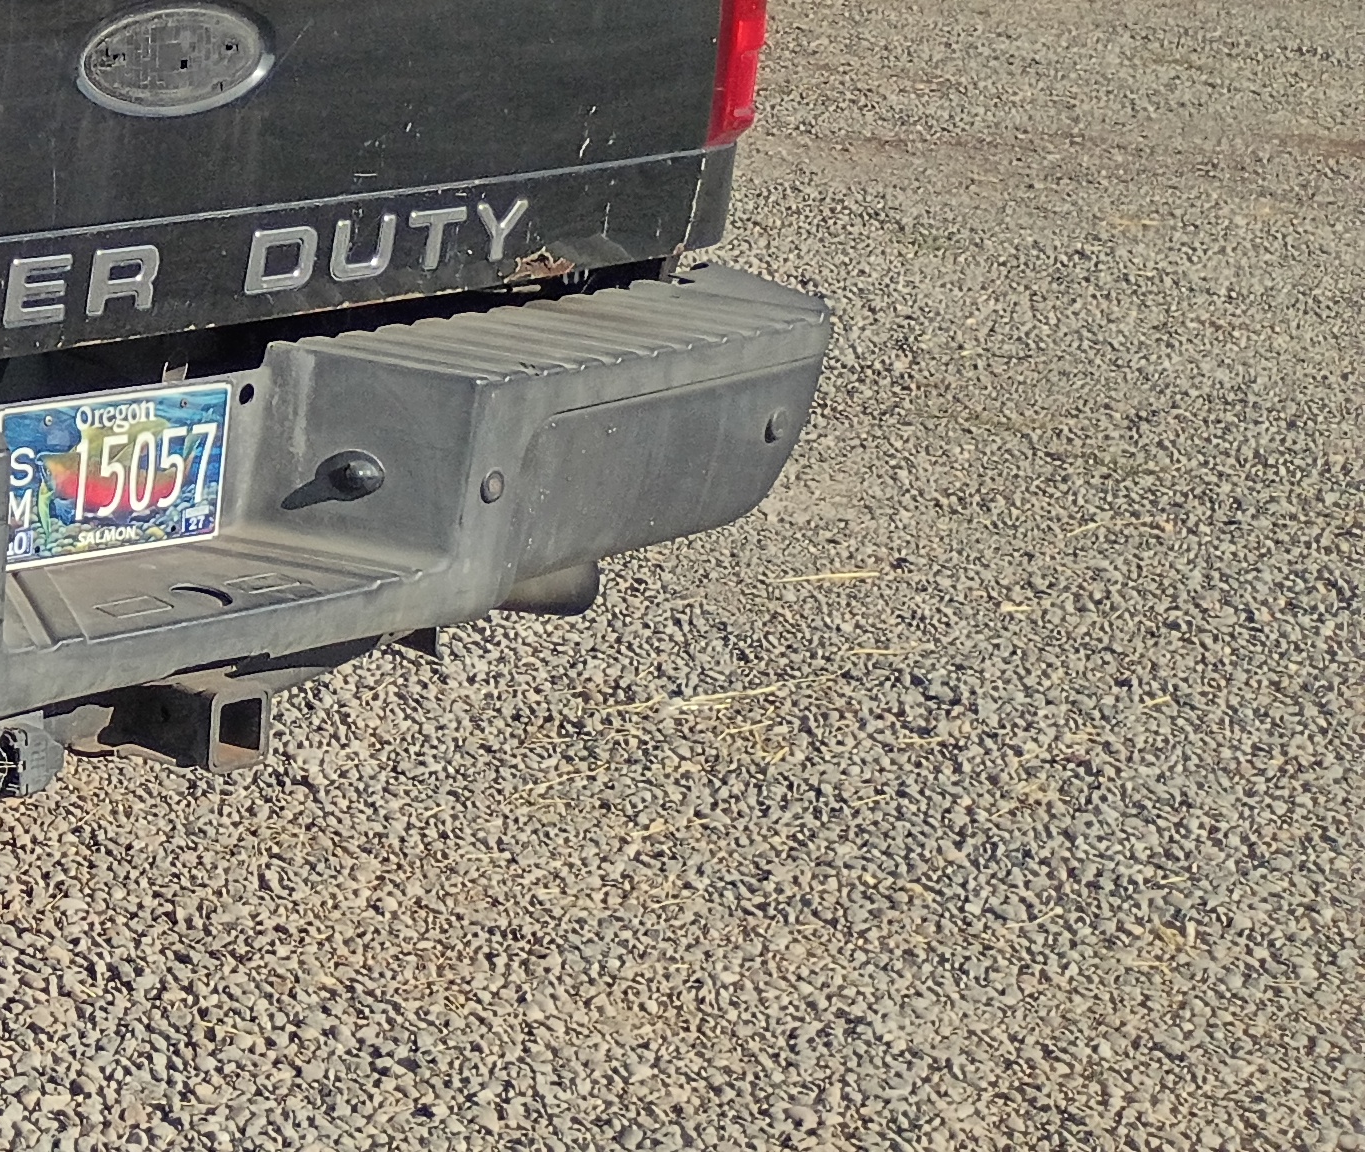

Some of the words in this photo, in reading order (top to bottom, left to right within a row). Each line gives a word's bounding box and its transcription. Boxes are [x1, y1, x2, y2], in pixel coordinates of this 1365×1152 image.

[243, 198, 529, 296] DUTY
[75, 399, 157, 433] Oregon
[74, 421, 219, 522] 15057
[77, 525, 138, 546] SALMON
[188, 515, 206, 531] 27
